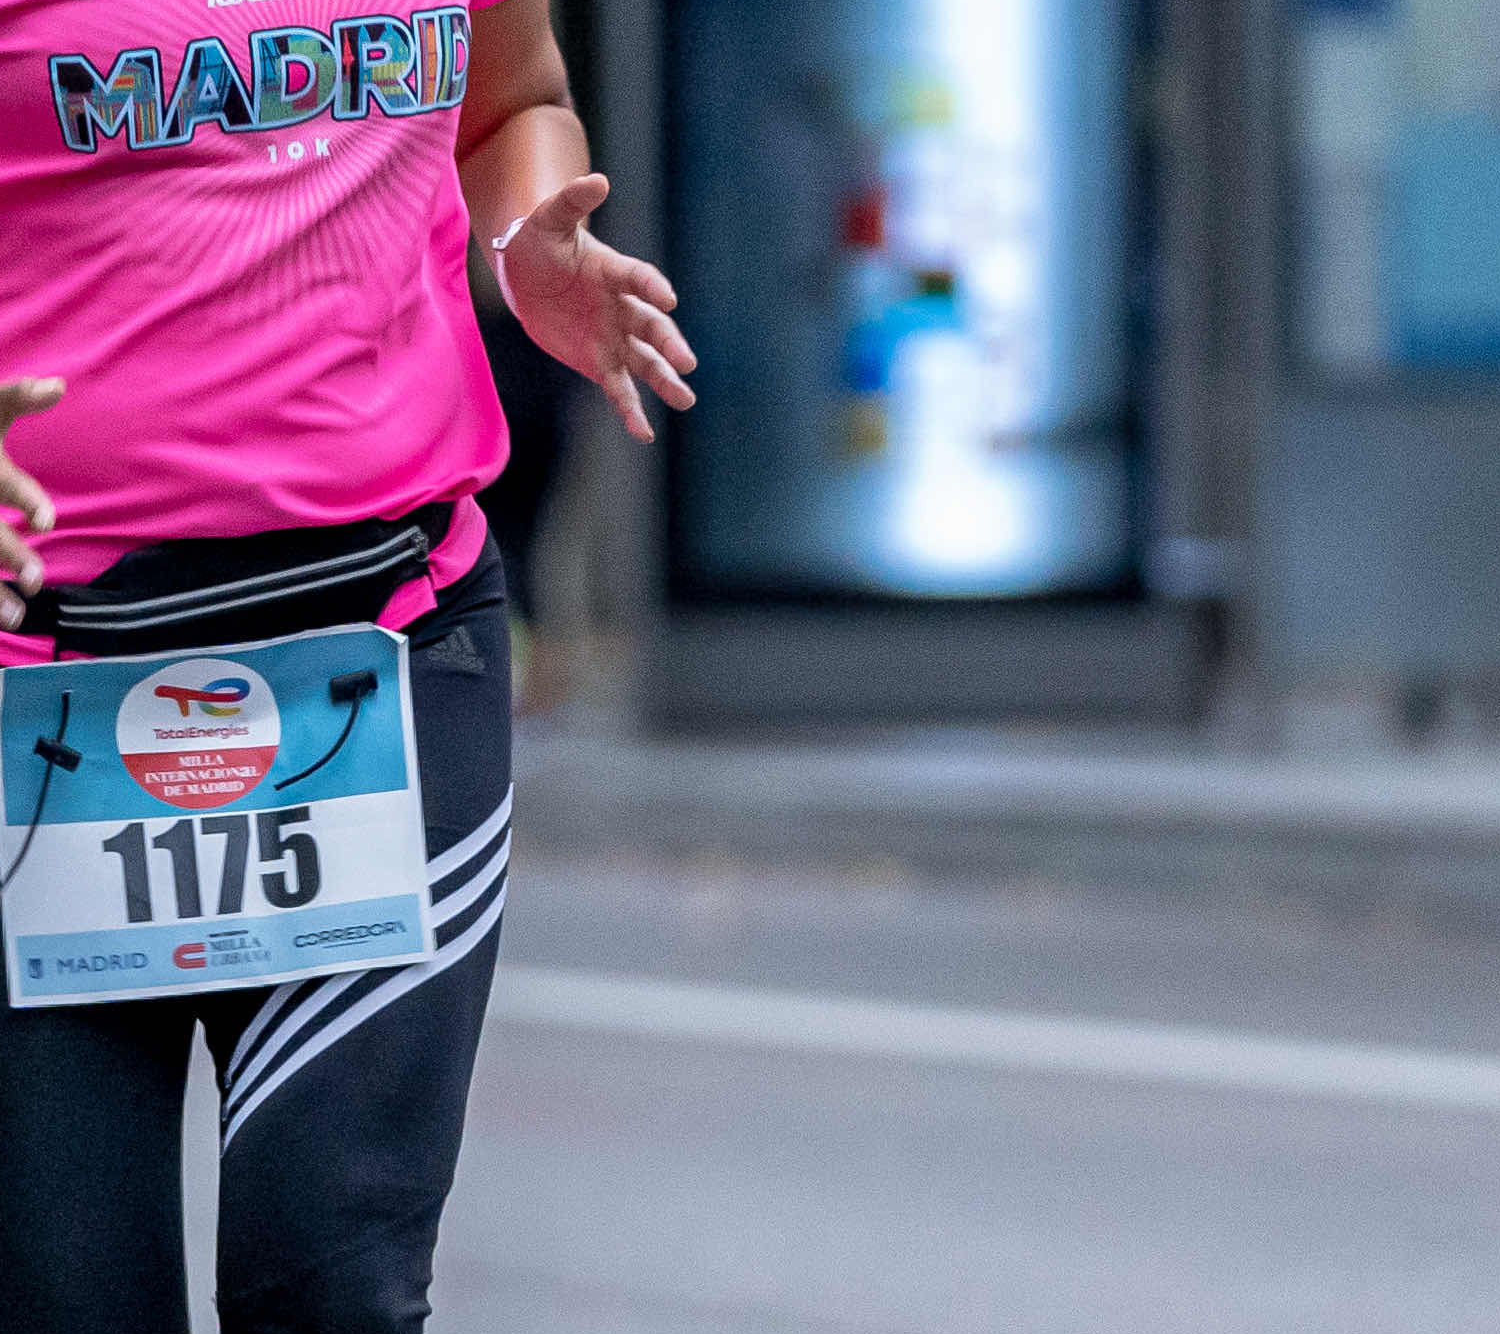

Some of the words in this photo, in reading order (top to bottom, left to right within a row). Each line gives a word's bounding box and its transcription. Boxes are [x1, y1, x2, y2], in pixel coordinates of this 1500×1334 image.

[152, 725, 249, 740] TotalEnergies
[178, 754, 225, 767] MILLA
[163, 784, 183, 797] DE
[187, 780, 246, 795] MADRID
[102, 806, 321, 923] 1175
[56, 952, 149, 973] MADRID
